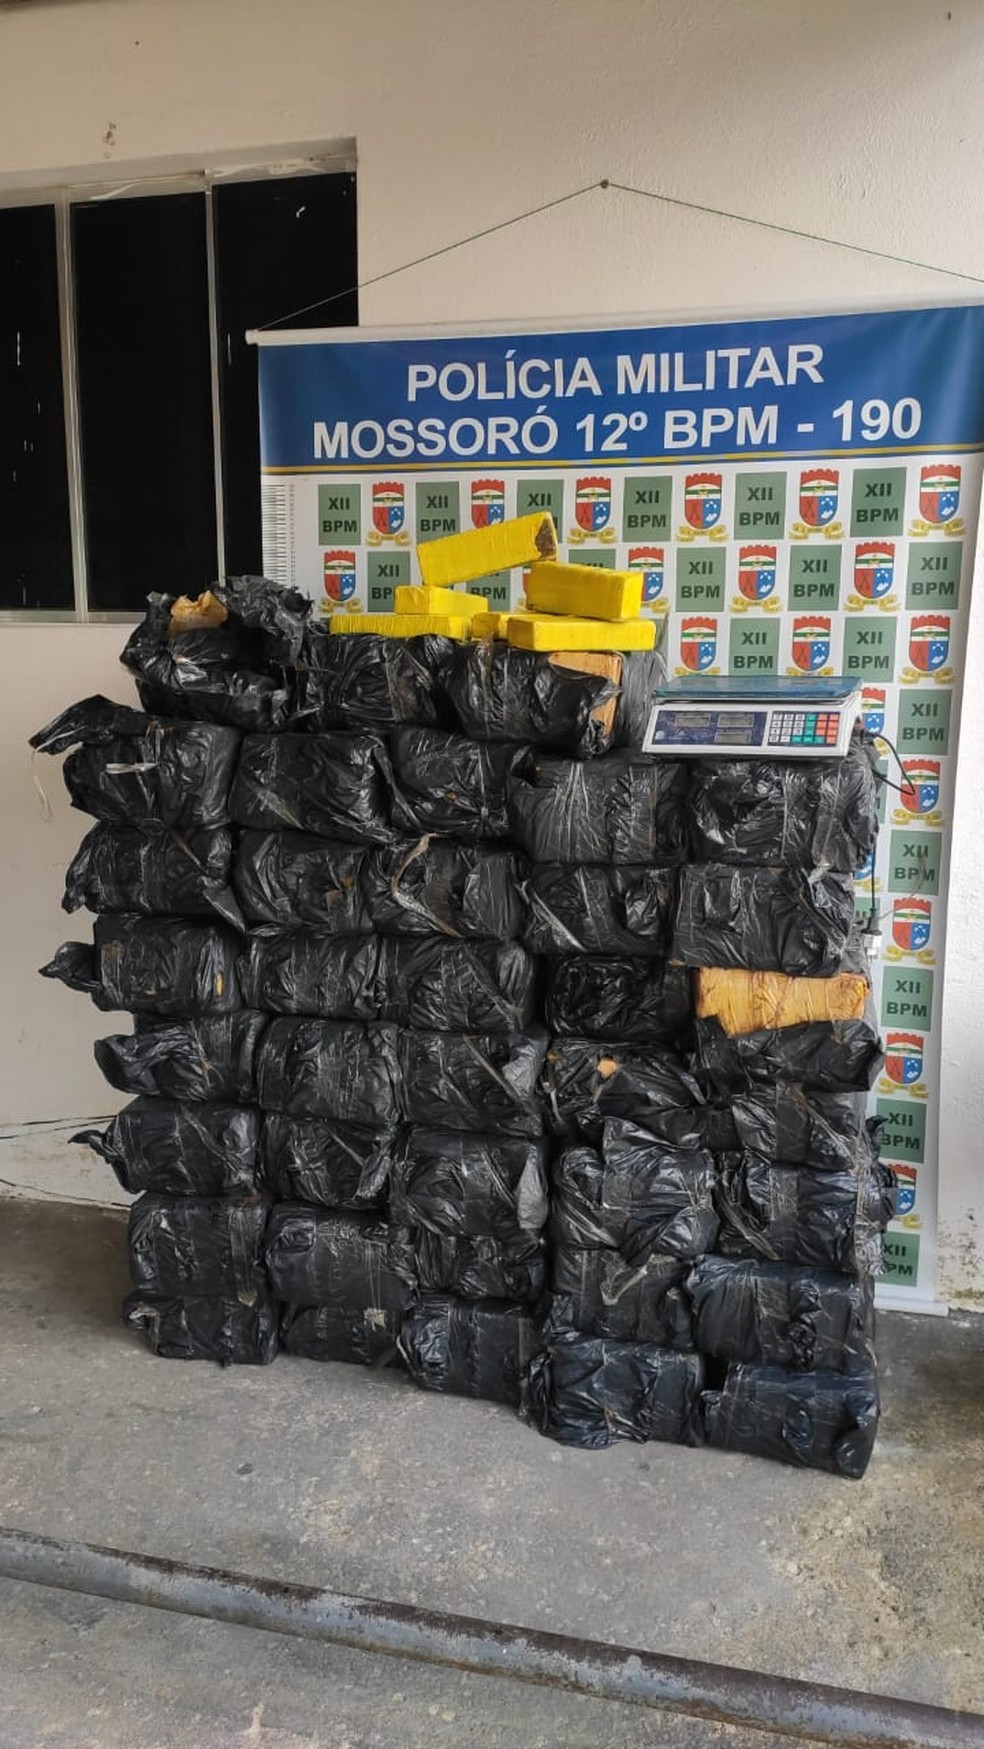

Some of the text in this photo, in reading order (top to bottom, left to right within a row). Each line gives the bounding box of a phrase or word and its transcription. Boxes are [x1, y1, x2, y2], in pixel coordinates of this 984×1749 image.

[407, 344, 824, 402] POLÍCIA MILITAR
[313, 398, 922, 459] MOSSORÓ 12º BPM - 190
[635, 490, 659, 504] XII
[748, 487, 773, 501] XII
[865, 483, 891, 497] XII
[328, 498, 349, 510] XII
[427, 496, 448, 508] XII
[528, 493, 551, 506] XII
[628, 515, 666, 528] BPM
[739, 512, 780, 526] BPM
[857, 508, 898, 523] BPM
[323, 520, 356, 532] BPM
[420, 519, 455, 531] BPM
[378, 565, 399, 577] XII
[689, 561, 713, 574] XII
[802, 559, 827, 573] XII
[920, 557, 947, 571] XII
[371, 587, 393, 600] BP
[681, 585, 720, 598] BPM
[794, 583, 834, 597] BPM
[911, 581, 955, 596] BPM
[742, 632, 766, 645] XII
[856, 632, 882, 644] XII
[734, 656, 773, 668] BPM
[848, 656, 889, 668] BPM
[911, 702, 938, 717] XII
[902, 727, 945, 742] BPM
[902, 844, 929, 858] XII
[894, 867, 935, 881] BPM
[896, 980, 921, 994] XII
[886, 1001, 928, 1017] BPM
[888, 1113, 914, 1127] XII
[886, 1263, 913, 1276] PM
